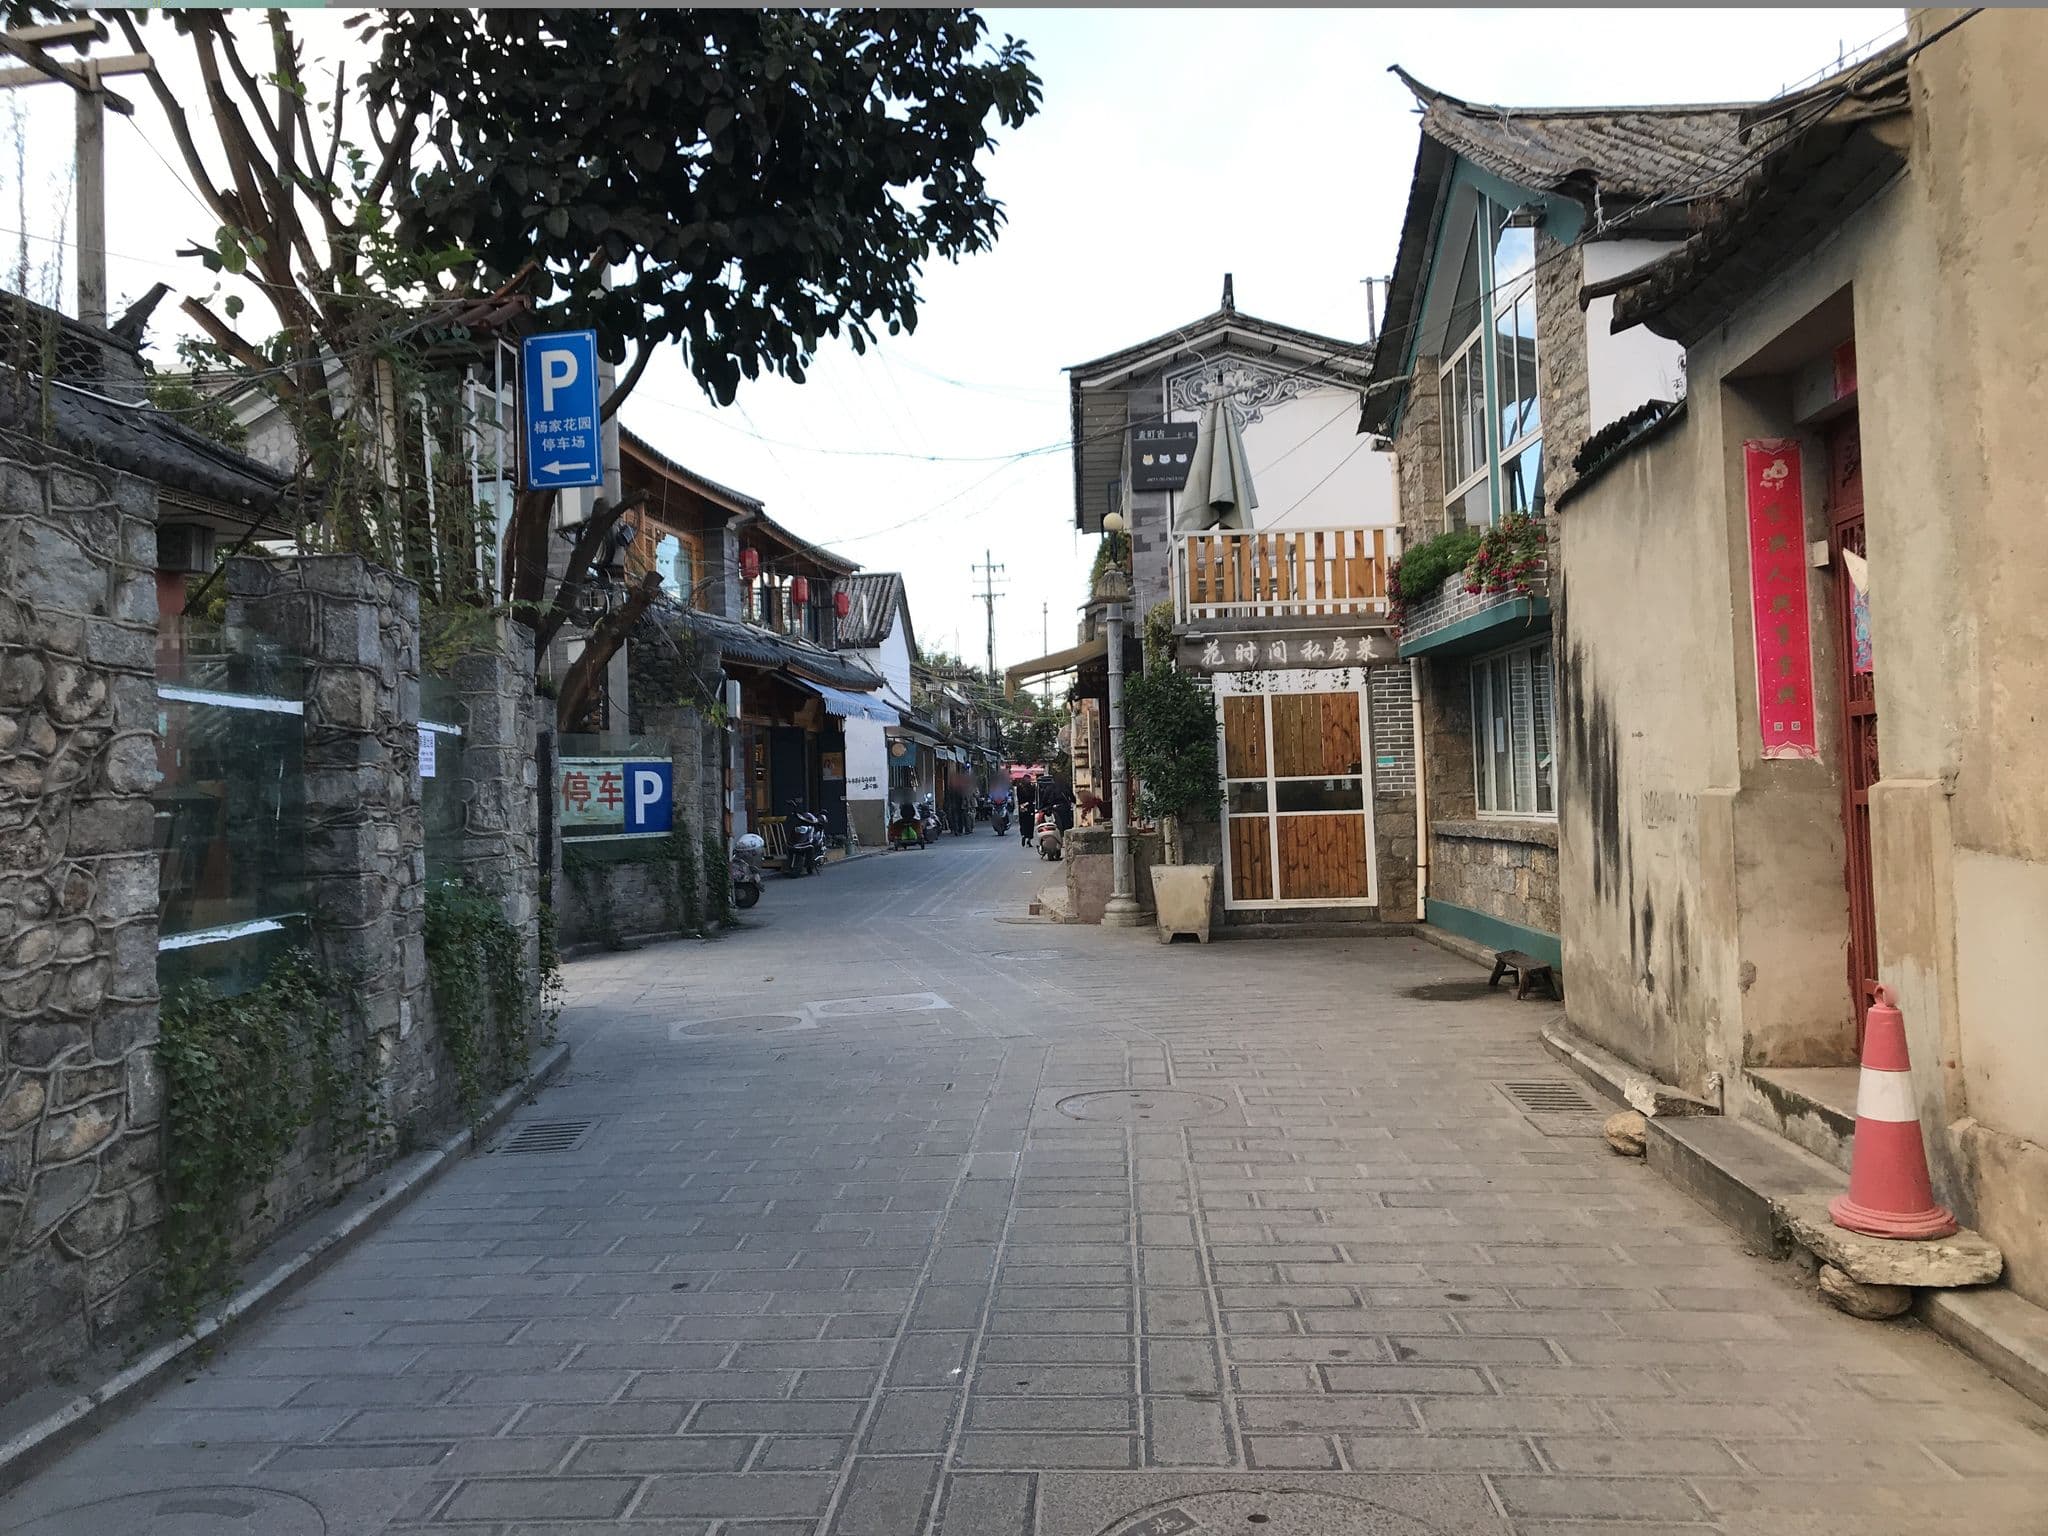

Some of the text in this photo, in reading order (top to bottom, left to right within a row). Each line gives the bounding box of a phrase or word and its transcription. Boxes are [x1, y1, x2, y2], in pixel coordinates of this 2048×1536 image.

[541, 349, 578, 412] P
[534, 417, 591, 434] 杨家花园
[542, 436, 585, 451] 停车场
[1201, 635, 1379, 665] 花时间私房菜
[561, 771, 623, 812] 停车
[634, 770, 663, 825] P
